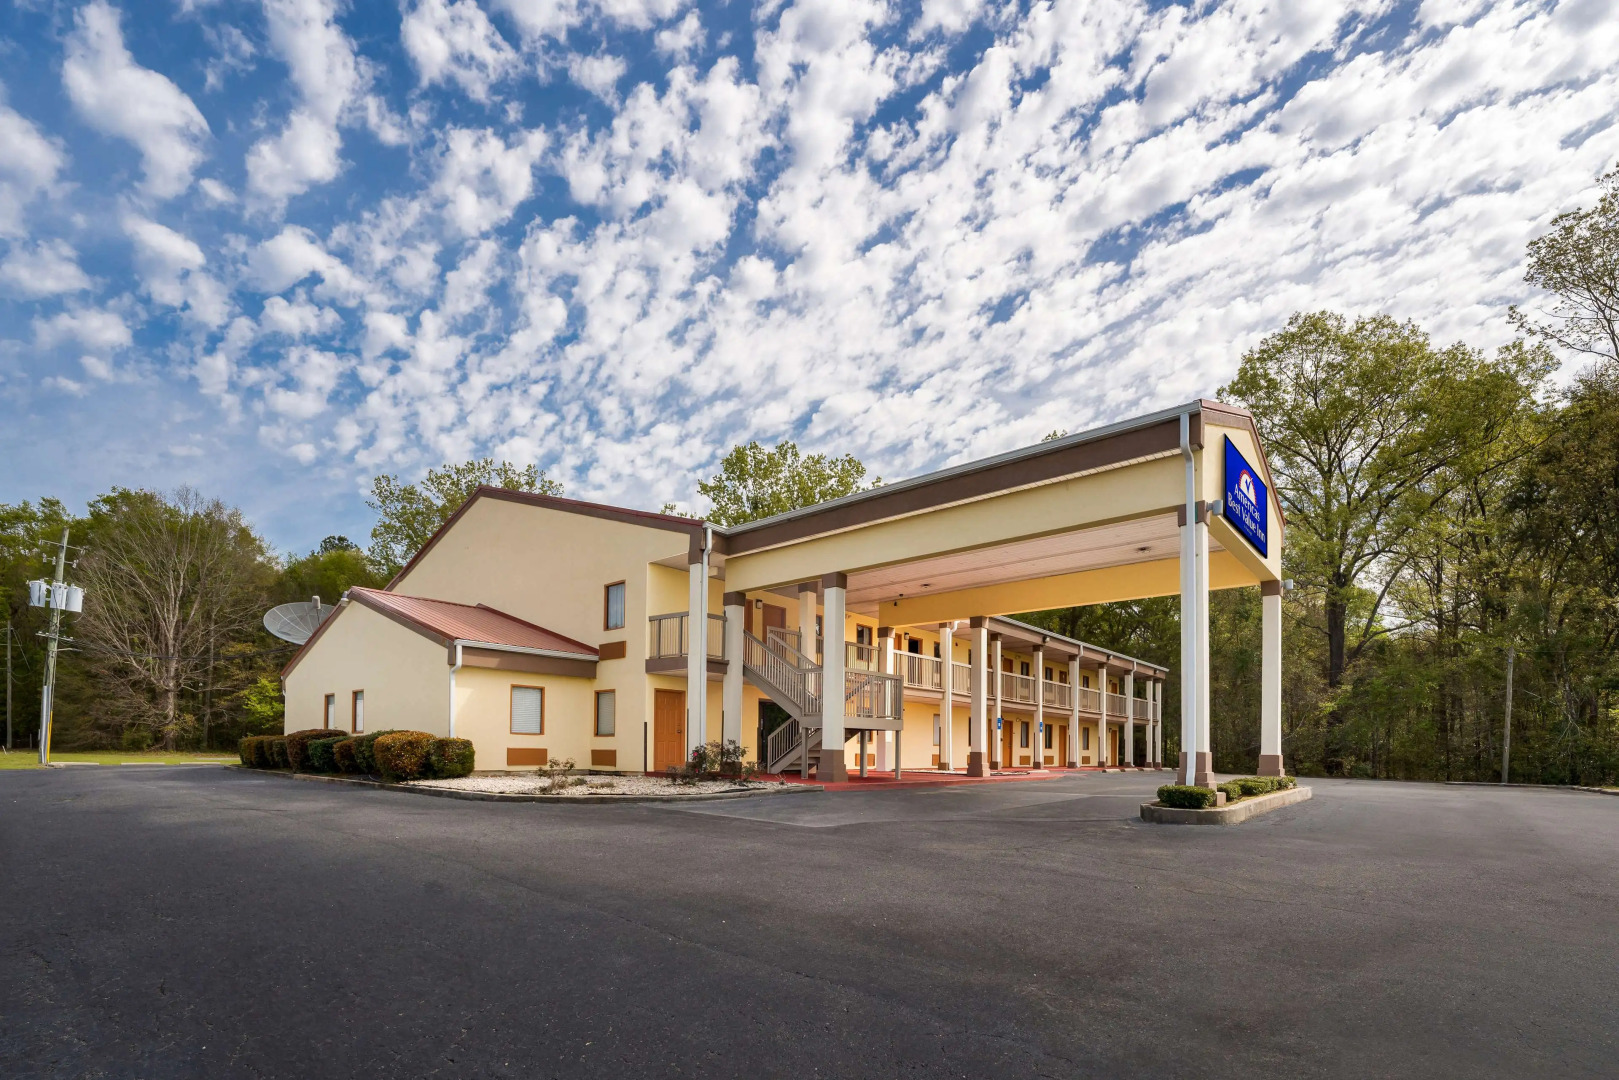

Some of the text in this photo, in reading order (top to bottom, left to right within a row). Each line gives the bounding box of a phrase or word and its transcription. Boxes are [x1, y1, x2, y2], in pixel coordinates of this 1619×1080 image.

[1228, 491, 1240, 517] Best
[1241, 506, 1257, 533] Value
[1256, 523, 1265, 543] Inn
[1234, 483, 1261, 522] Americas
